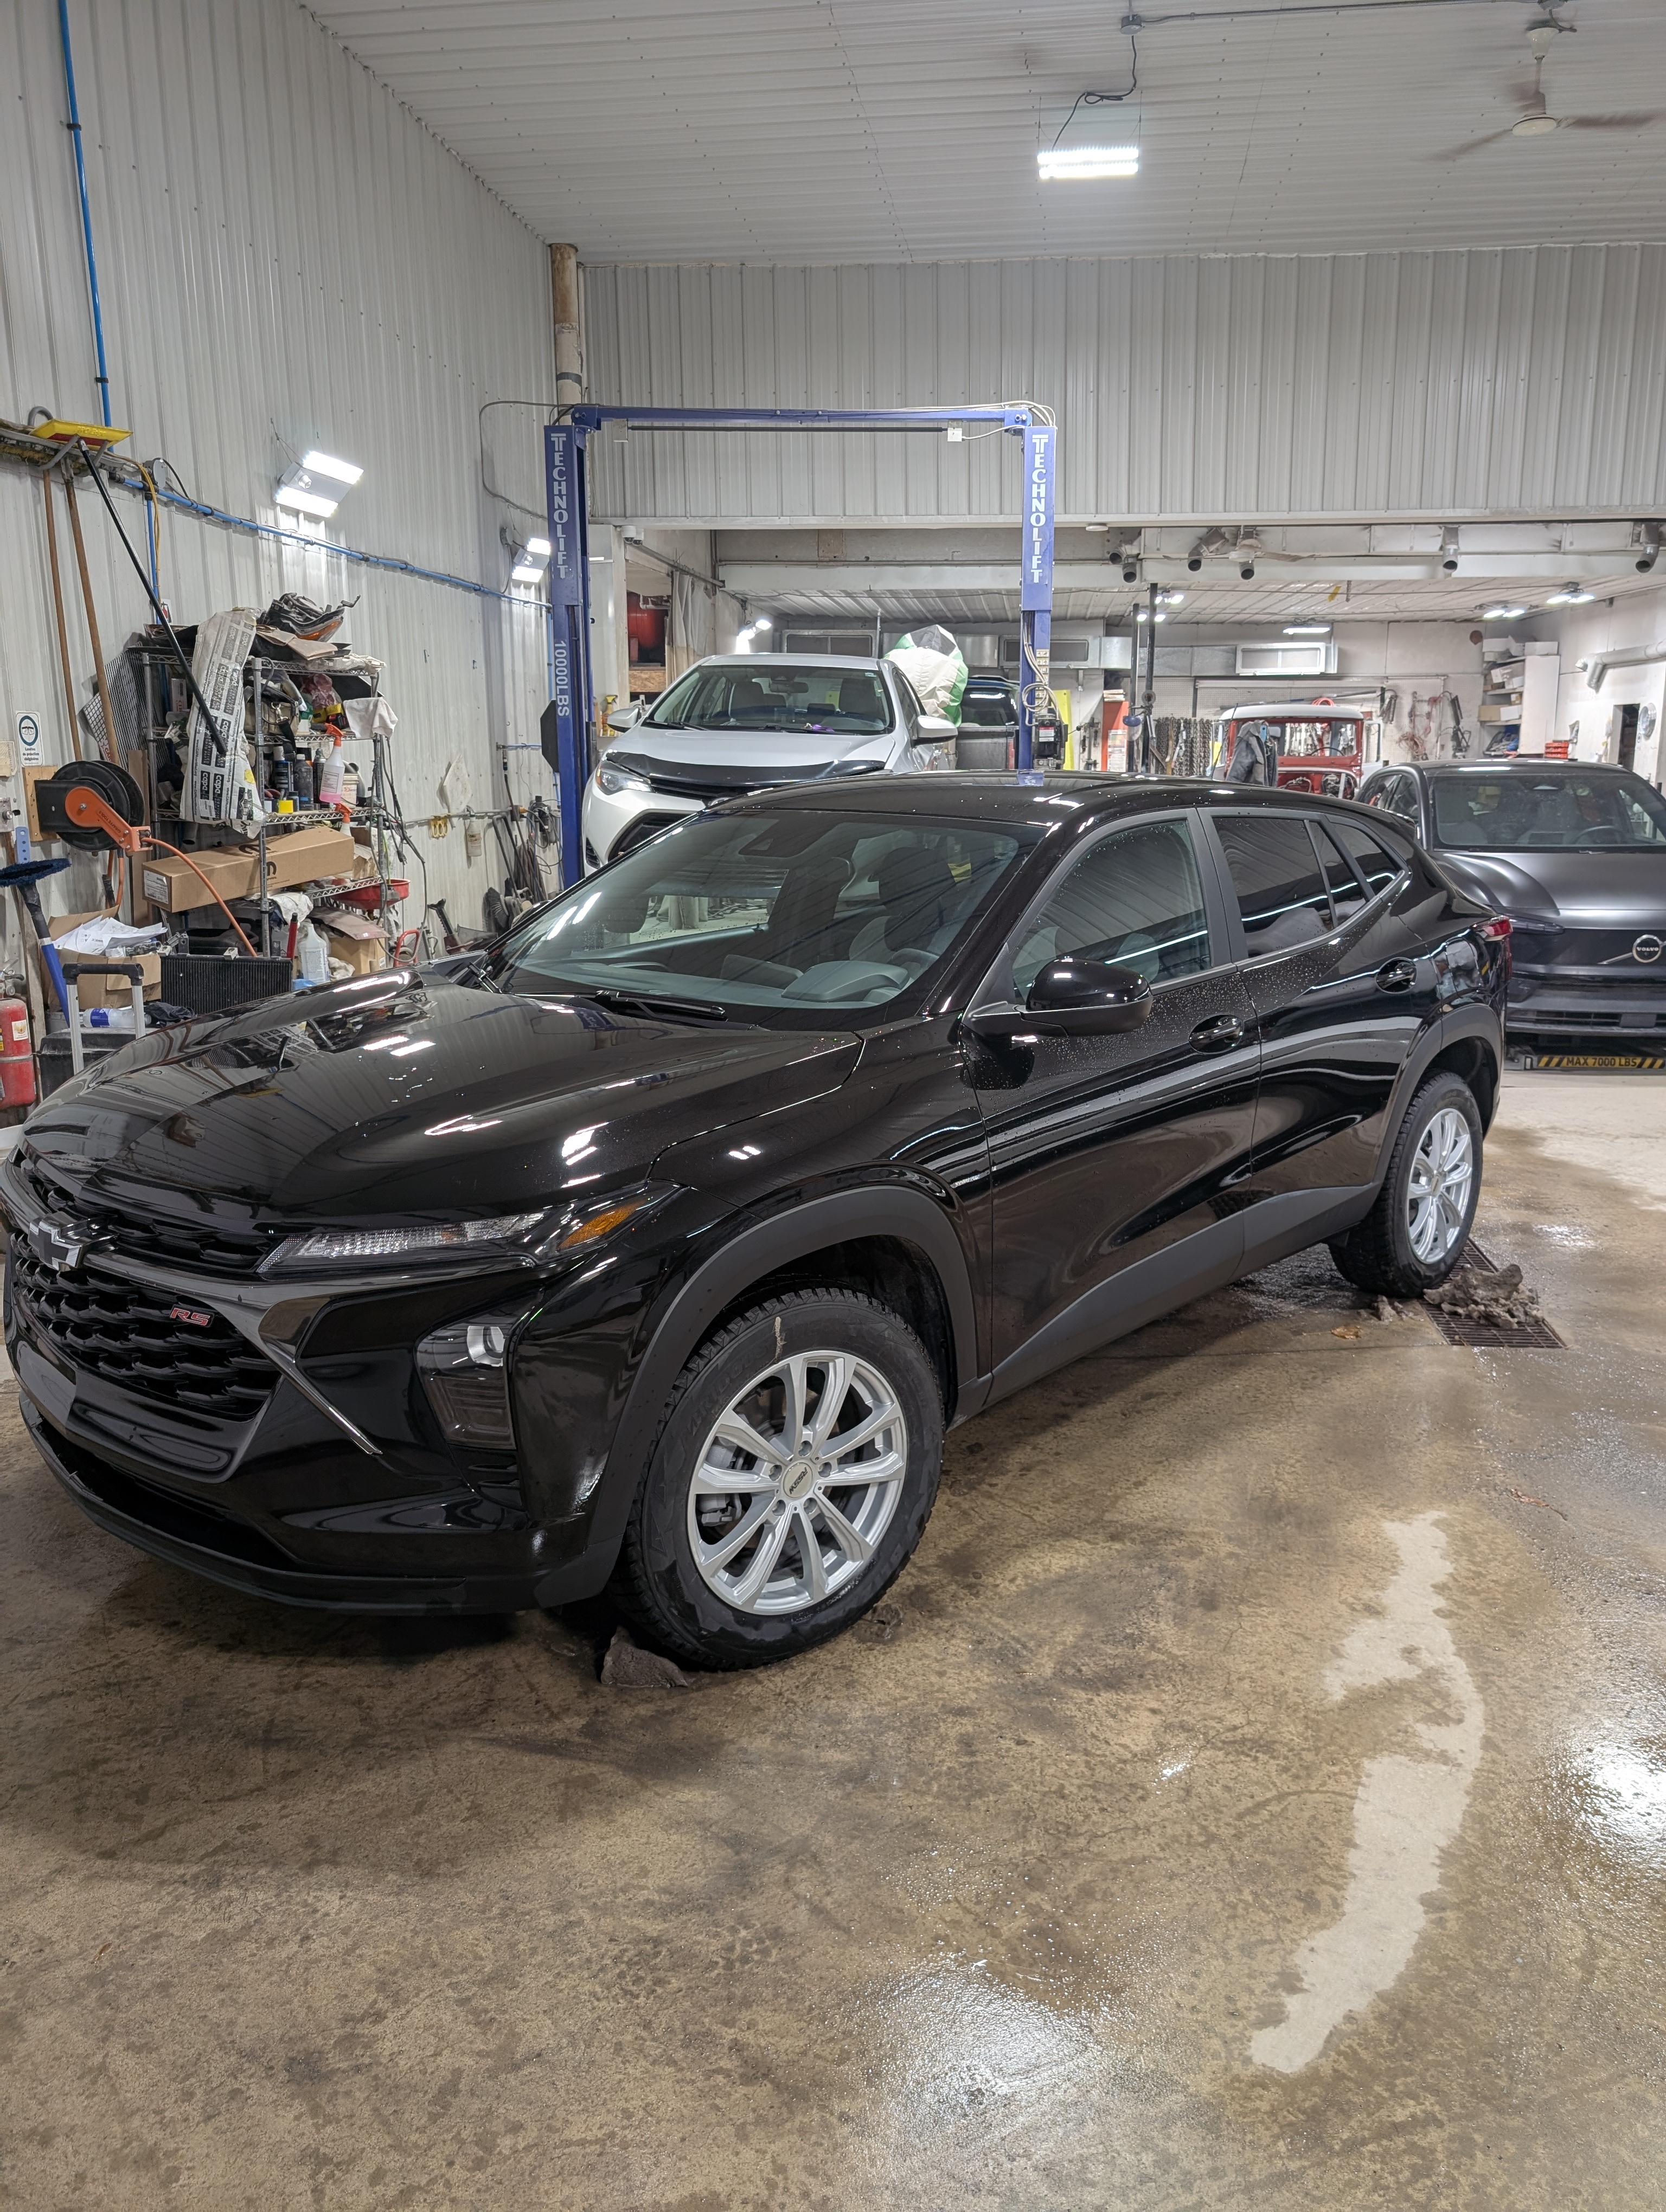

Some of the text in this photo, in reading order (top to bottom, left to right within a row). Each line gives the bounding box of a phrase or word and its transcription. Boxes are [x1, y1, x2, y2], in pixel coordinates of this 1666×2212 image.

[550, 433, 568, 580] TECHNOLIFT
[1030, 435, 1049, 583] TECHNOLIFT
[555, 640, 569, 716] 10000LBS
[98, 811, 109, 821] TOOLS
[1566, 1057, 1637, 1067] MAX 7000 LBS
[170, 1307, 210, 1326] RS
[789, 1467, 808, 1495] RSSW
